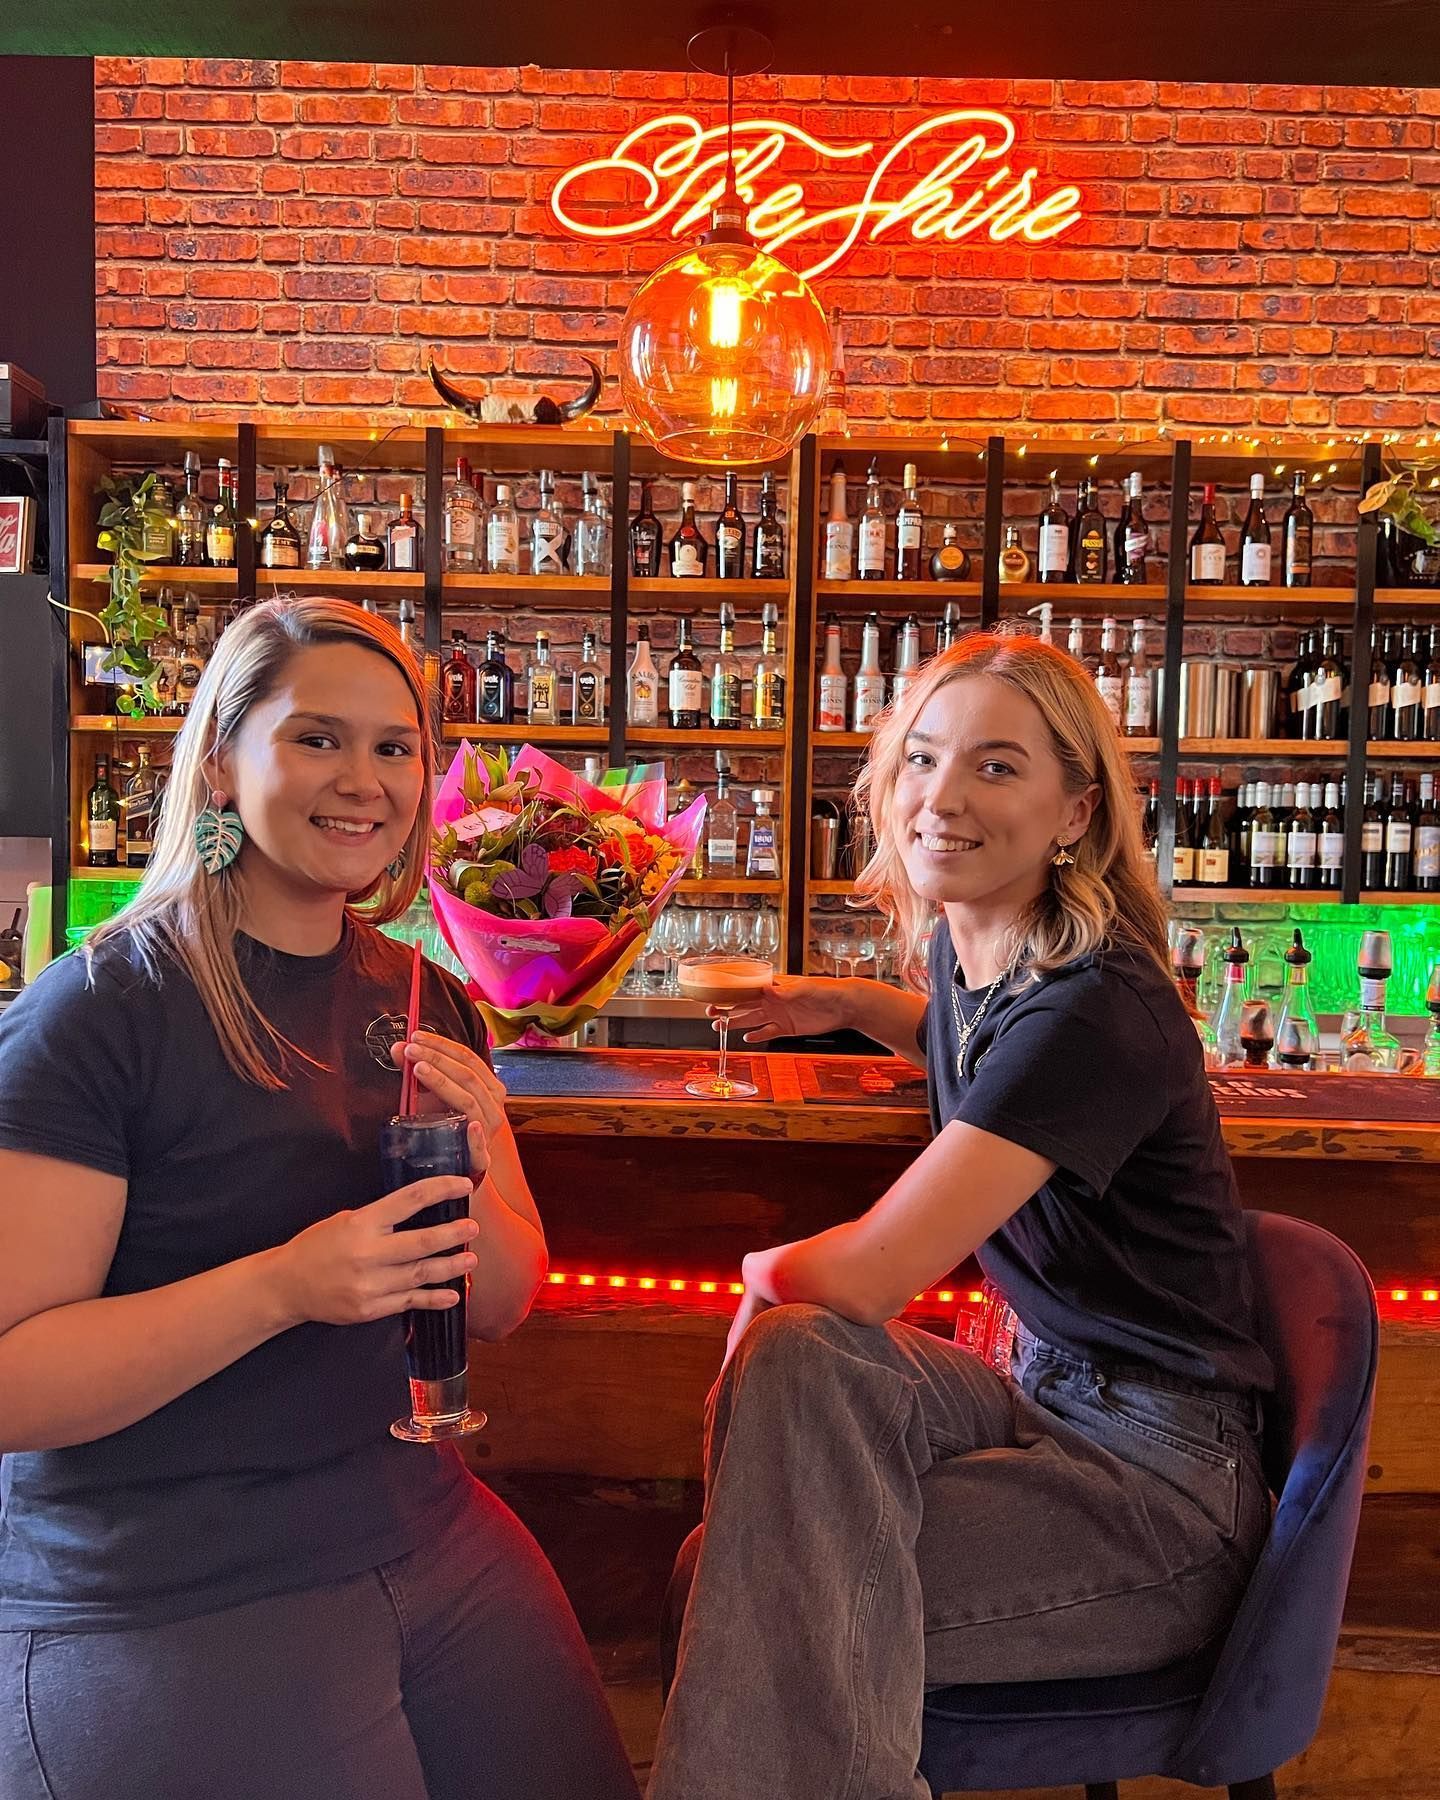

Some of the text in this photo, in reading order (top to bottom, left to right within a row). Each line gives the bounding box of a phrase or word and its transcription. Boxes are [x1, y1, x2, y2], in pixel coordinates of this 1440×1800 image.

[550, 109, 1083, 280] The Shire
[754, 835, 773, 843] 1800
